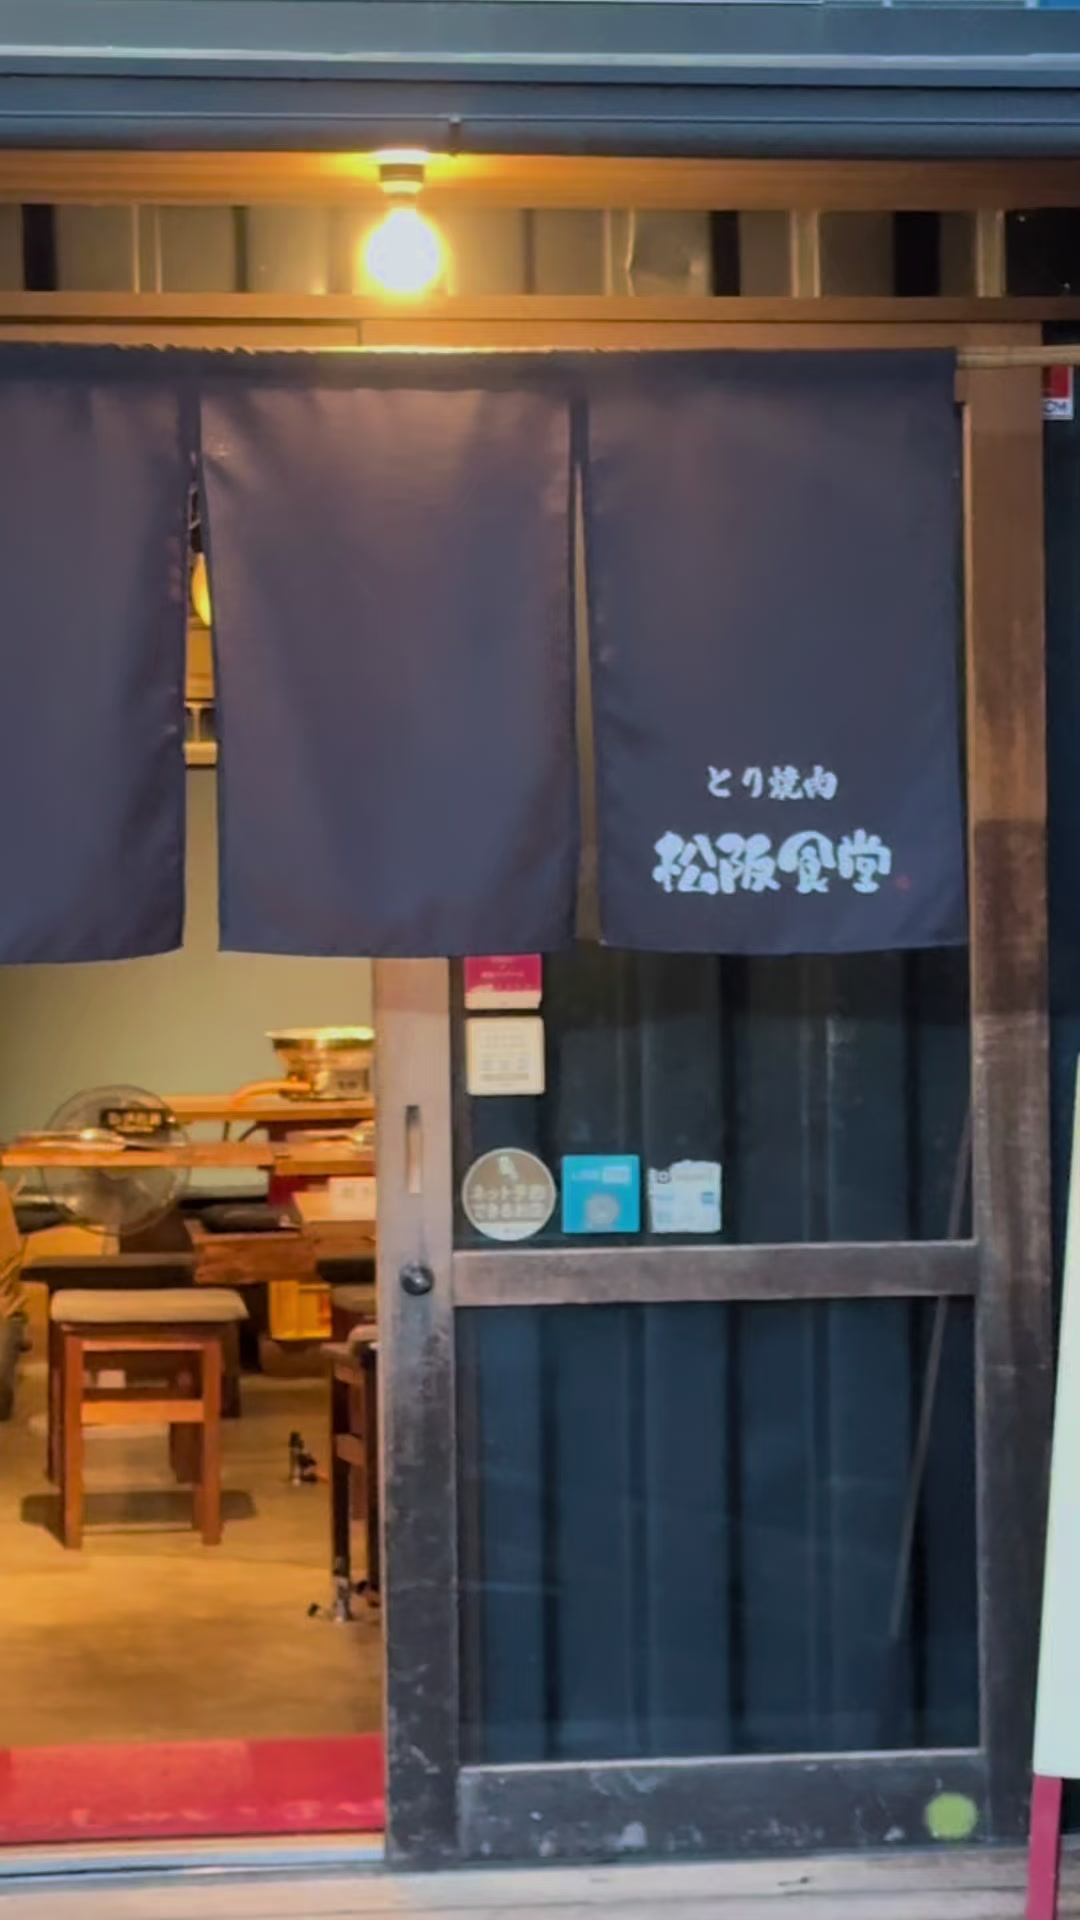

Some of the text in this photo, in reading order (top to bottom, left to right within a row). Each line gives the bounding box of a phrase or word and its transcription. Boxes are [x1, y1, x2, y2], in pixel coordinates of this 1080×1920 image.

[707, 765, 838, 800] とり焼肉
[652, 828, 892, 895] 松阪食堂
